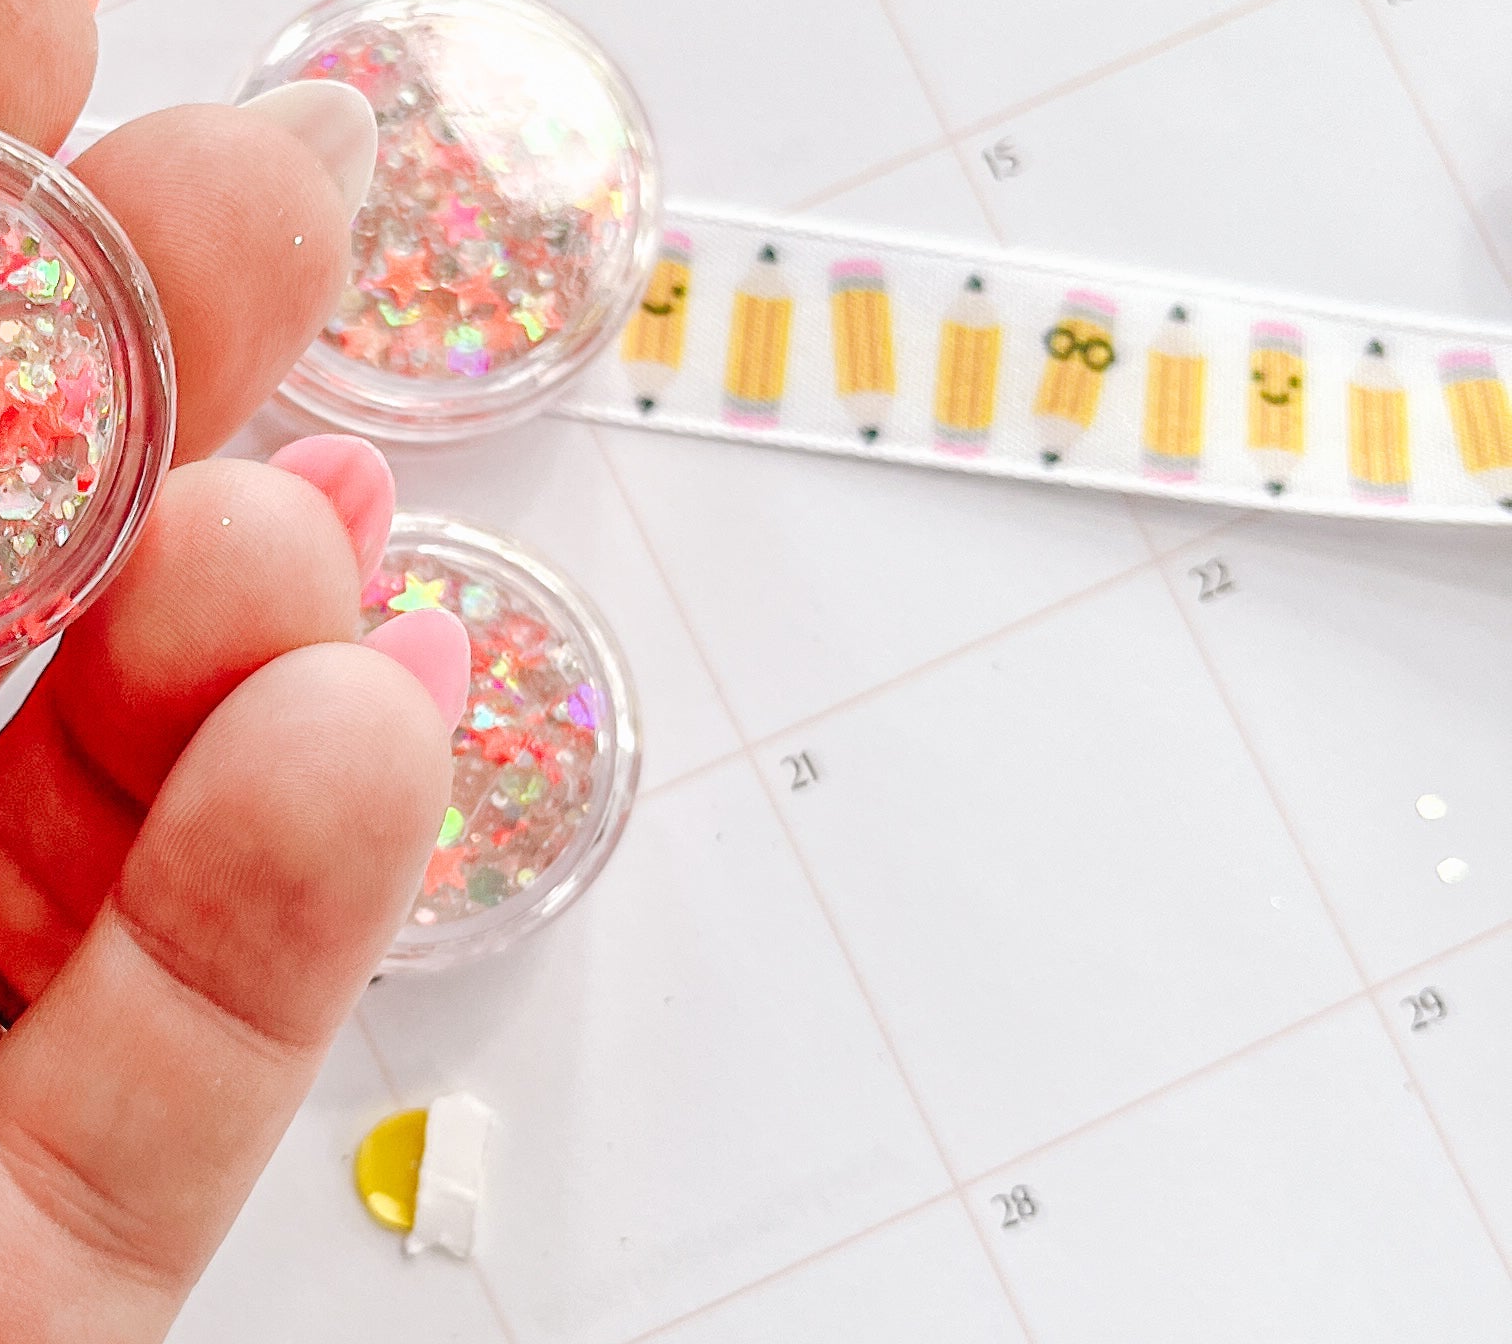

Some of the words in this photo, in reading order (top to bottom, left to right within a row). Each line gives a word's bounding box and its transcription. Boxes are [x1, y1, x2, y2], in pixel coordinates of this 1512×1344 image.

[982, 138, 1022, 181] 15
[1191, 559, 1235, 602] 22
[780, 751, 820, 791] 21
[1402, 986, 1448, 1032] 29
[991, 1185, 1038, 1229] 28
